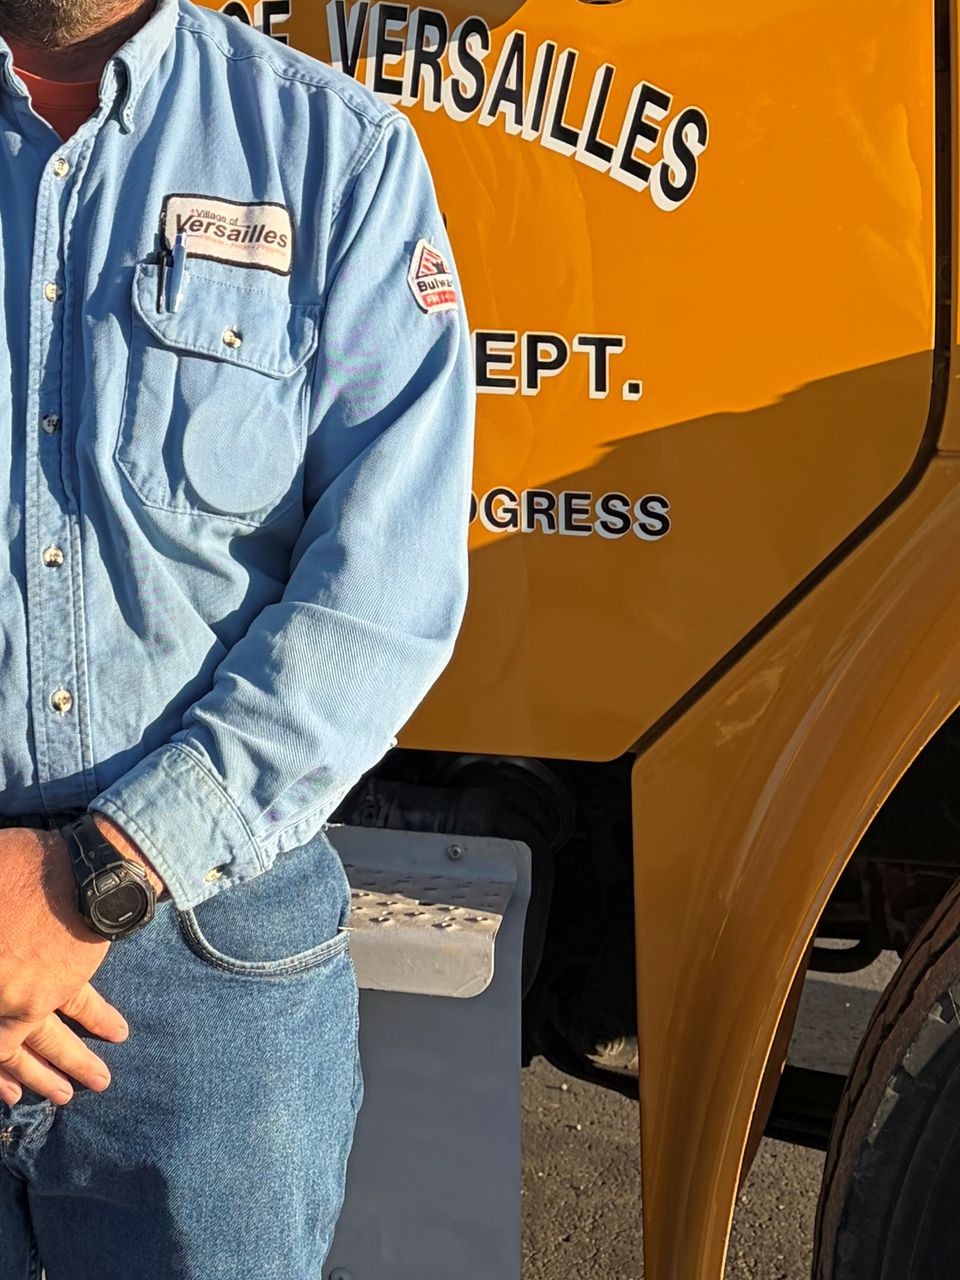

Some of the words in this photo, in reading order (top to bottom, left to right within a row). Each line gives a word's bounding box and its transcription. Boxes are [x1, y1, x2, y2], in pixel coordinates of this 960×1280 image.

[176, 213, 288, 248] Versailles
[195, 208, 227, 224] Village
[229, 217, 239, 226] of
[473, 329, 642, 400] EPT.
